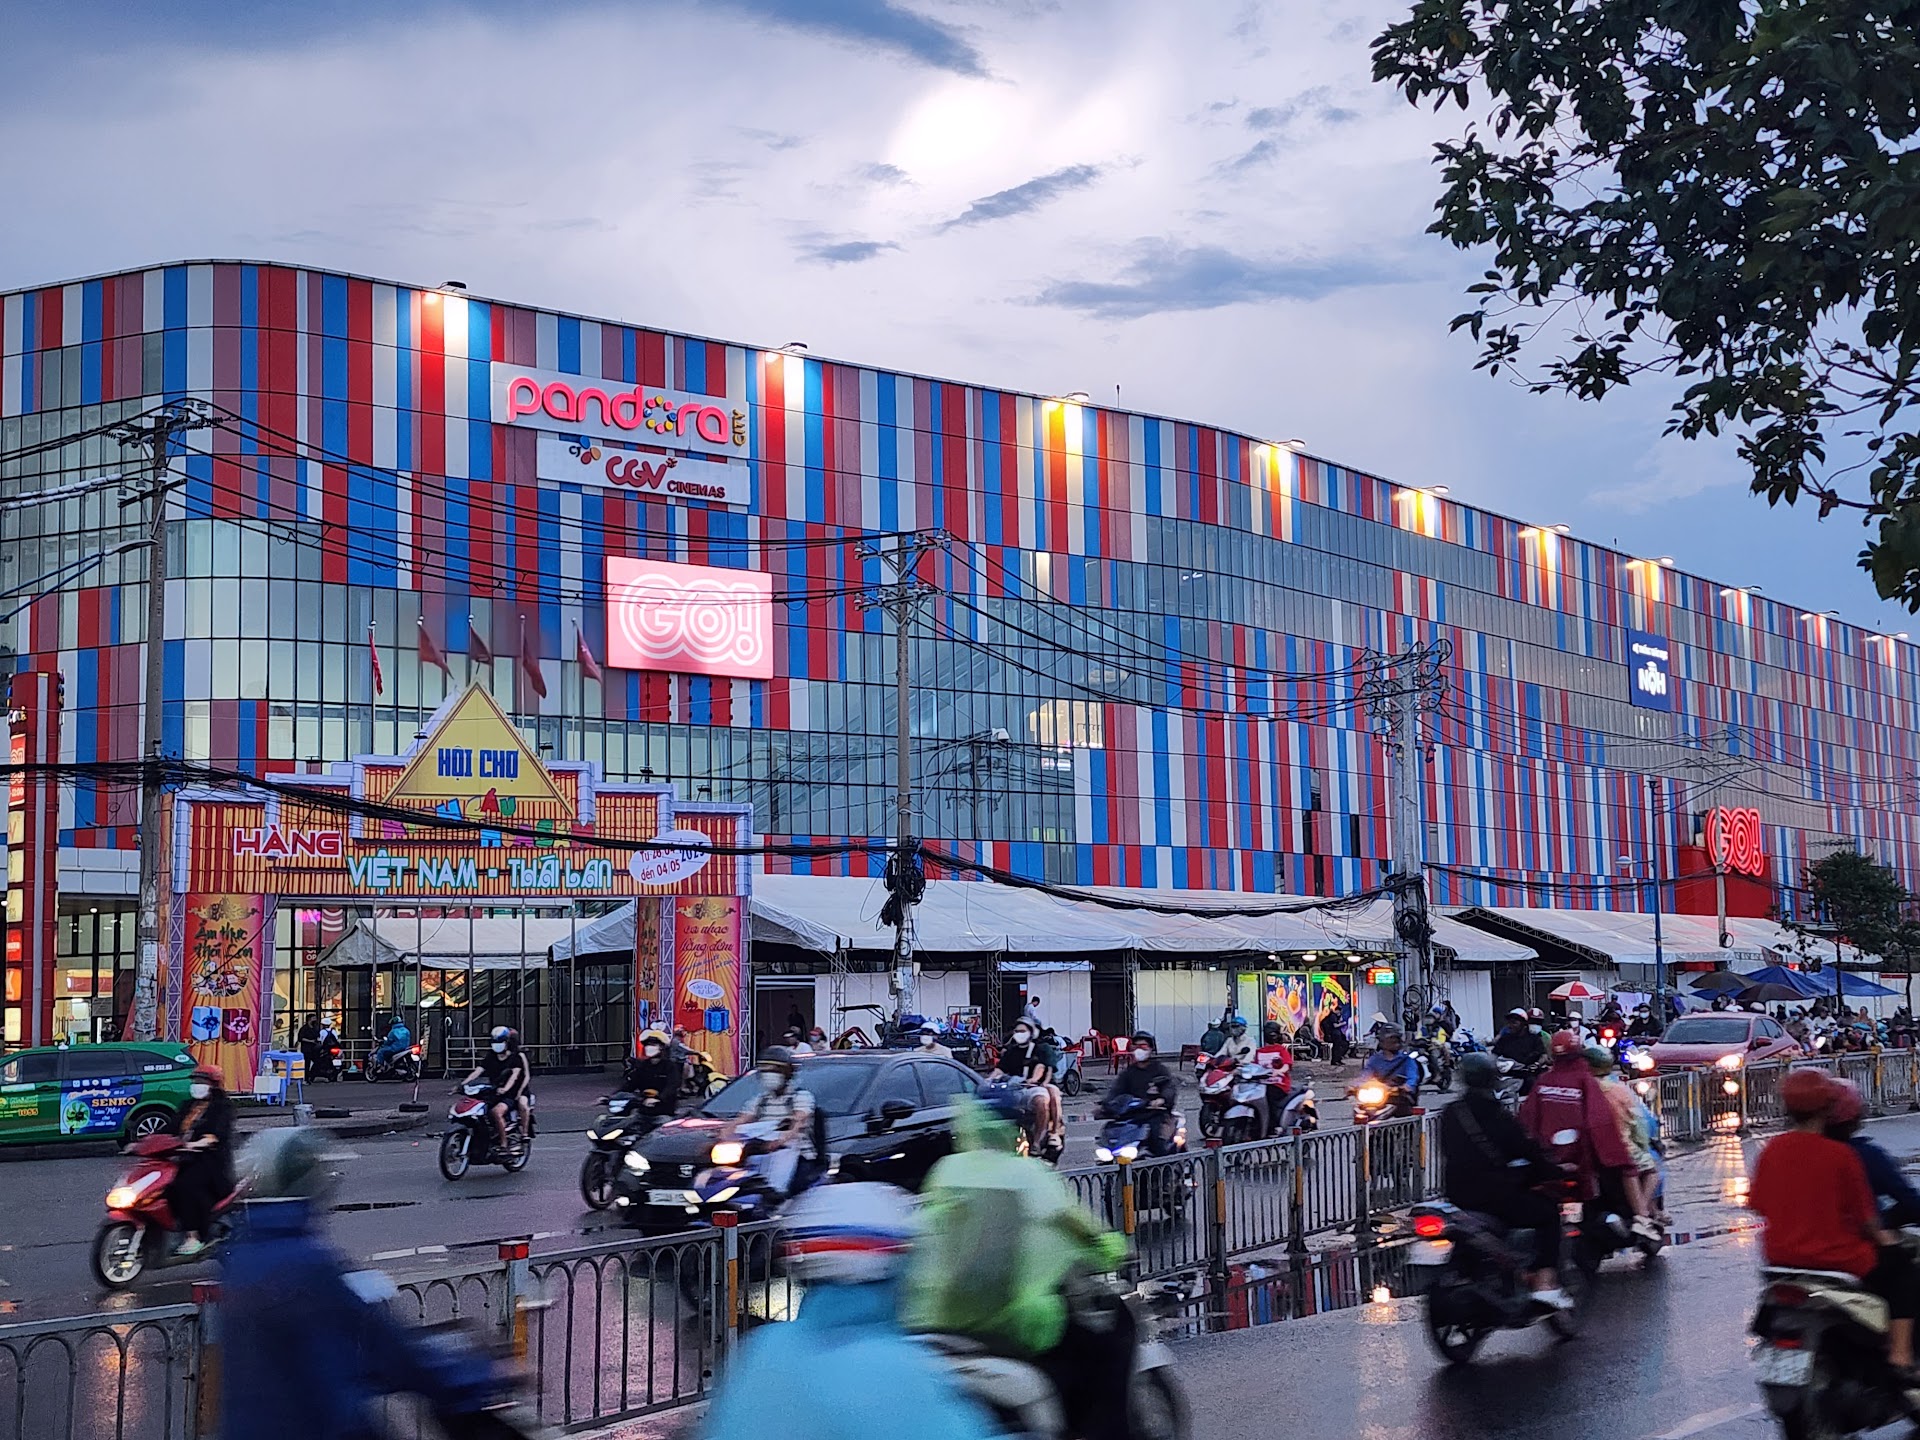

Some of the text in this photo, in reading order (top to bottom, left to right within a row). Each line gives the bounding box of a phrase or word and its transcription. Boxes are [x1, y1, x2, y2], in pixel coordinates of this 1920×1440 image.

[507, 376, 729, 444] pandora
[732, 408, 746, 447] CITY
[605, 455, 669, 490] CGV
[666, 479, 726, 499] CINEMAS
[618, 573, 763, 666] GO!
[233, 822, 342, 858] HÀNG
[1703, 805, 1763, 877] GO!
[347, 847, 409, 897] VIỆT
[418, 857, 478, 889] NAM
[91, 1097, 137, 1108] SENKO
